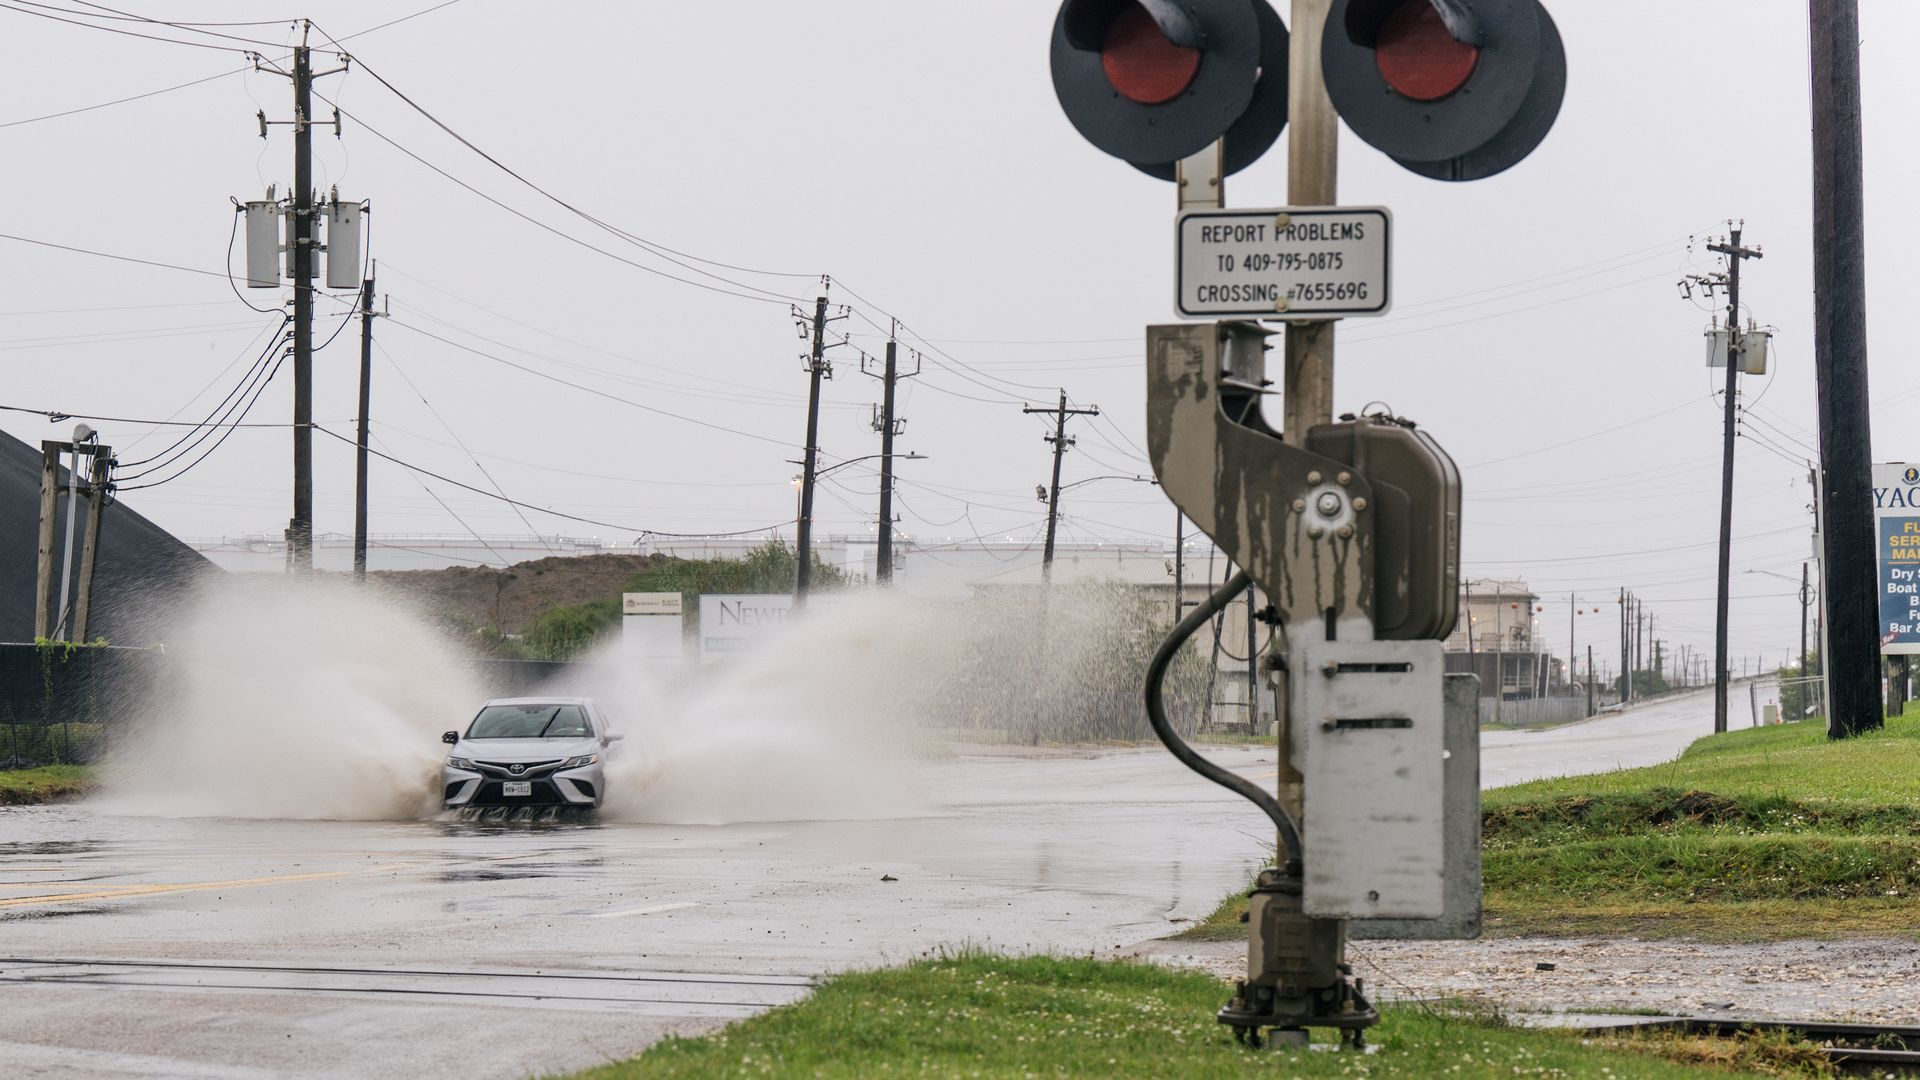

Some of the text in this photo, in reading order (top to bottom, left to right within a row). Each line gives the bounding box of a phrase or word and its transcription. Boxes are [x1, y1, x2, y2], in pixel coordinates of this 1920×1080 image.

[1202, 223, 1364, 243] REPORT PROBLEMS
[1218, 252, 1343, 272] TO 409-795-0875
[1198, 282, 1368, 303] CROSSING #765569G
[1891, 568, 1914, 581] Dry
[1887, 583, 1917, 593] Boat
[1889, 623, 1912, 633] Bar
